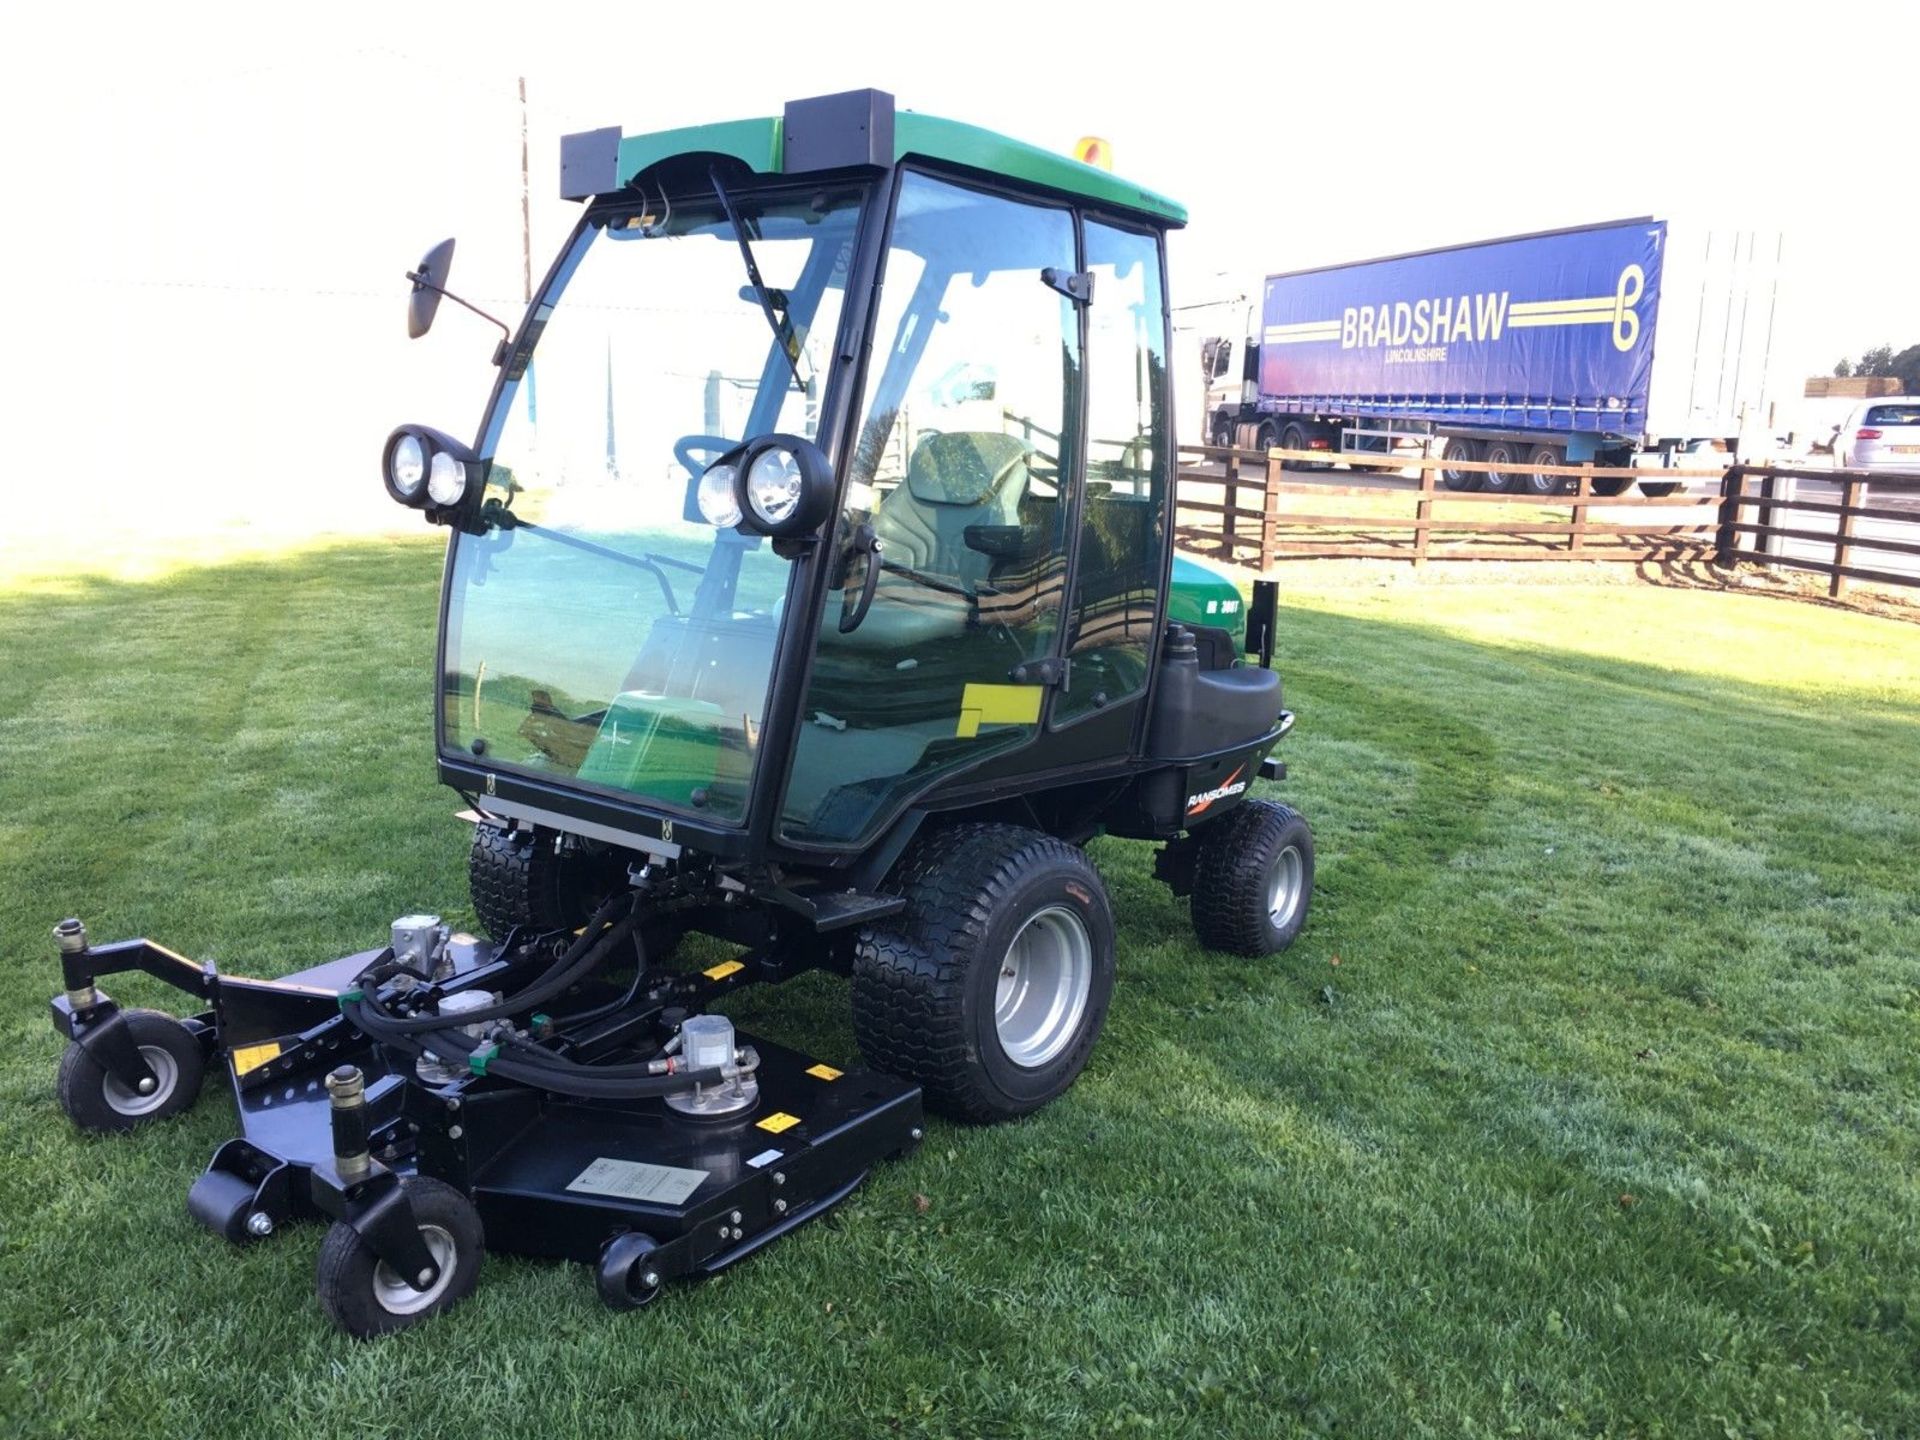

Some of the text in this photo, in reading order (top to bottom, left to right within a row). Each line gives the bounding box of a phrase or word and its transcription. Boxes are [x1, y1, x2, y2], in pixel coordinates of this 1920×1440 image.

[1341, 291, 1510, 350] BRADSHAW
[1385, 347, 1447, 363] LINCOLNSHIRE
[1187, 781, 1247, 807] RANSOMES
